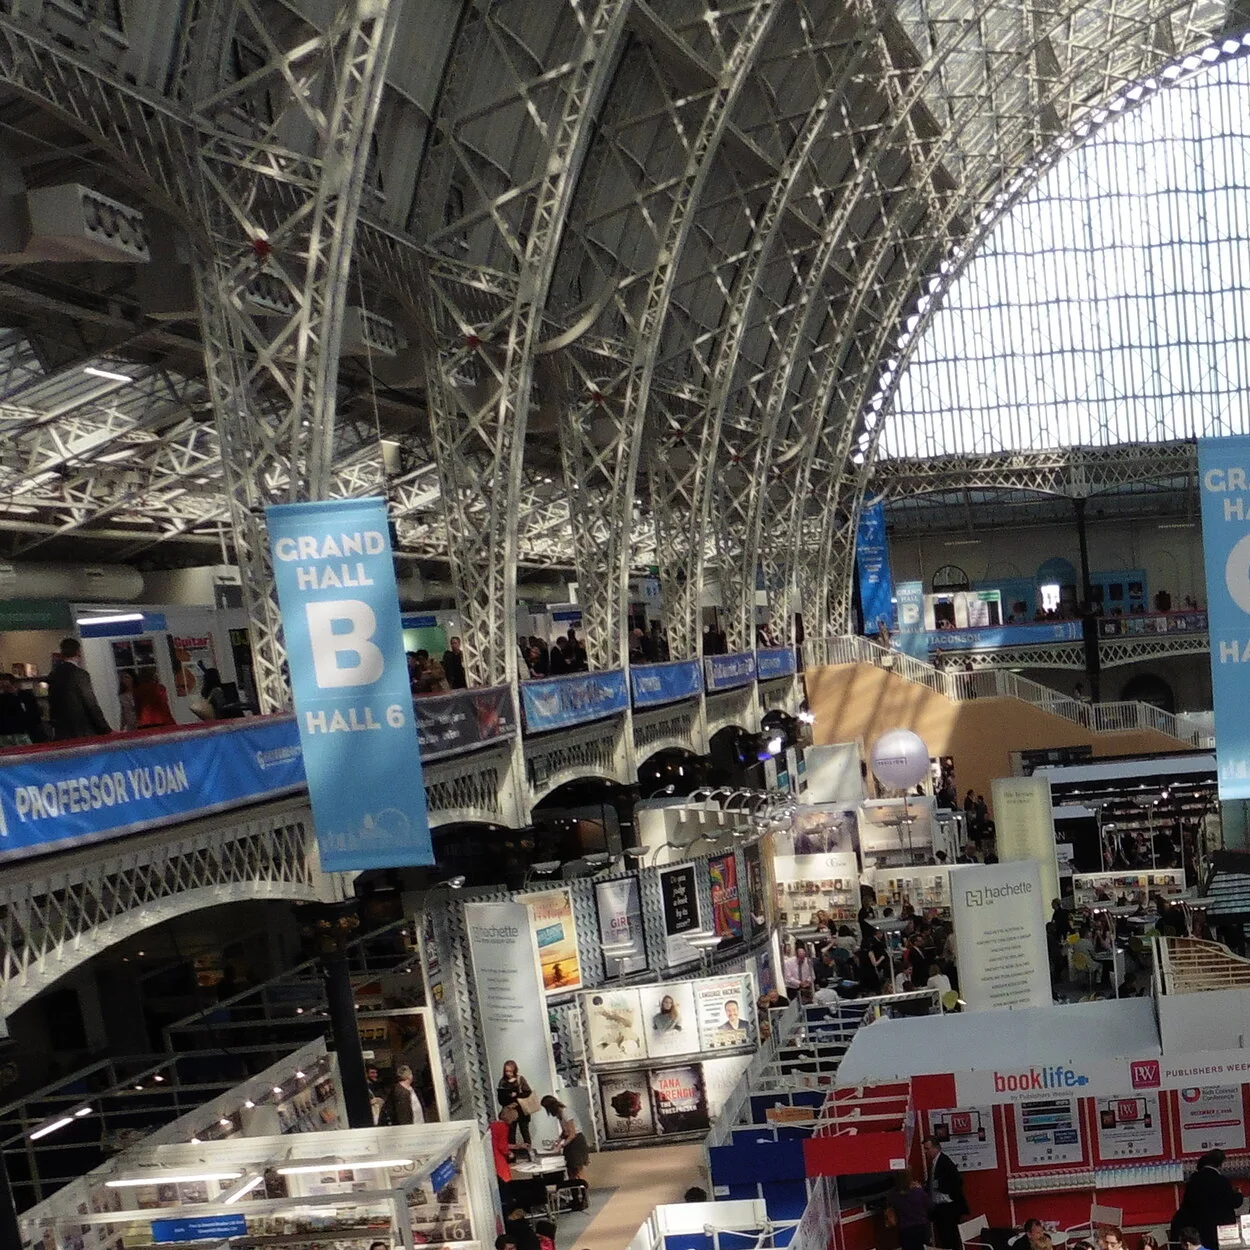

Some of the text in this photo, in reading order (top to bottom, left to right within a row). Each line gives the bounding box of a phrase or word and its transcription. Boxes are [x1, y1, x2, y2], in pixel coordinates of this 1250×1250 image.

[274, 530, 385, 562] GRAND
[296, 563, 374, 590] HALL
[902, 603, 920, 624] B
[305, 600, 385, 689] B
[306, 708, 381, 735] HALL
[386, 704, 405, 729] 6
[15, 771, 130, 823] PROFESSOR
[127, 767, 152, 799] YU
[154, 761, 190, 796] DAN
[985, 882, 1032, 898] hachette
[610, 917, 630, 928] GIRL
[699, 986, 741, 999] LANGUAGE HACKING
[993, 1065, 1075, 1093] booklife
[1165, 1065, 1224, 1078] PUBLISHERS
[659, 1078, 680, 1089] TANA
[659, 1087, 694, 1101] FRENCH
